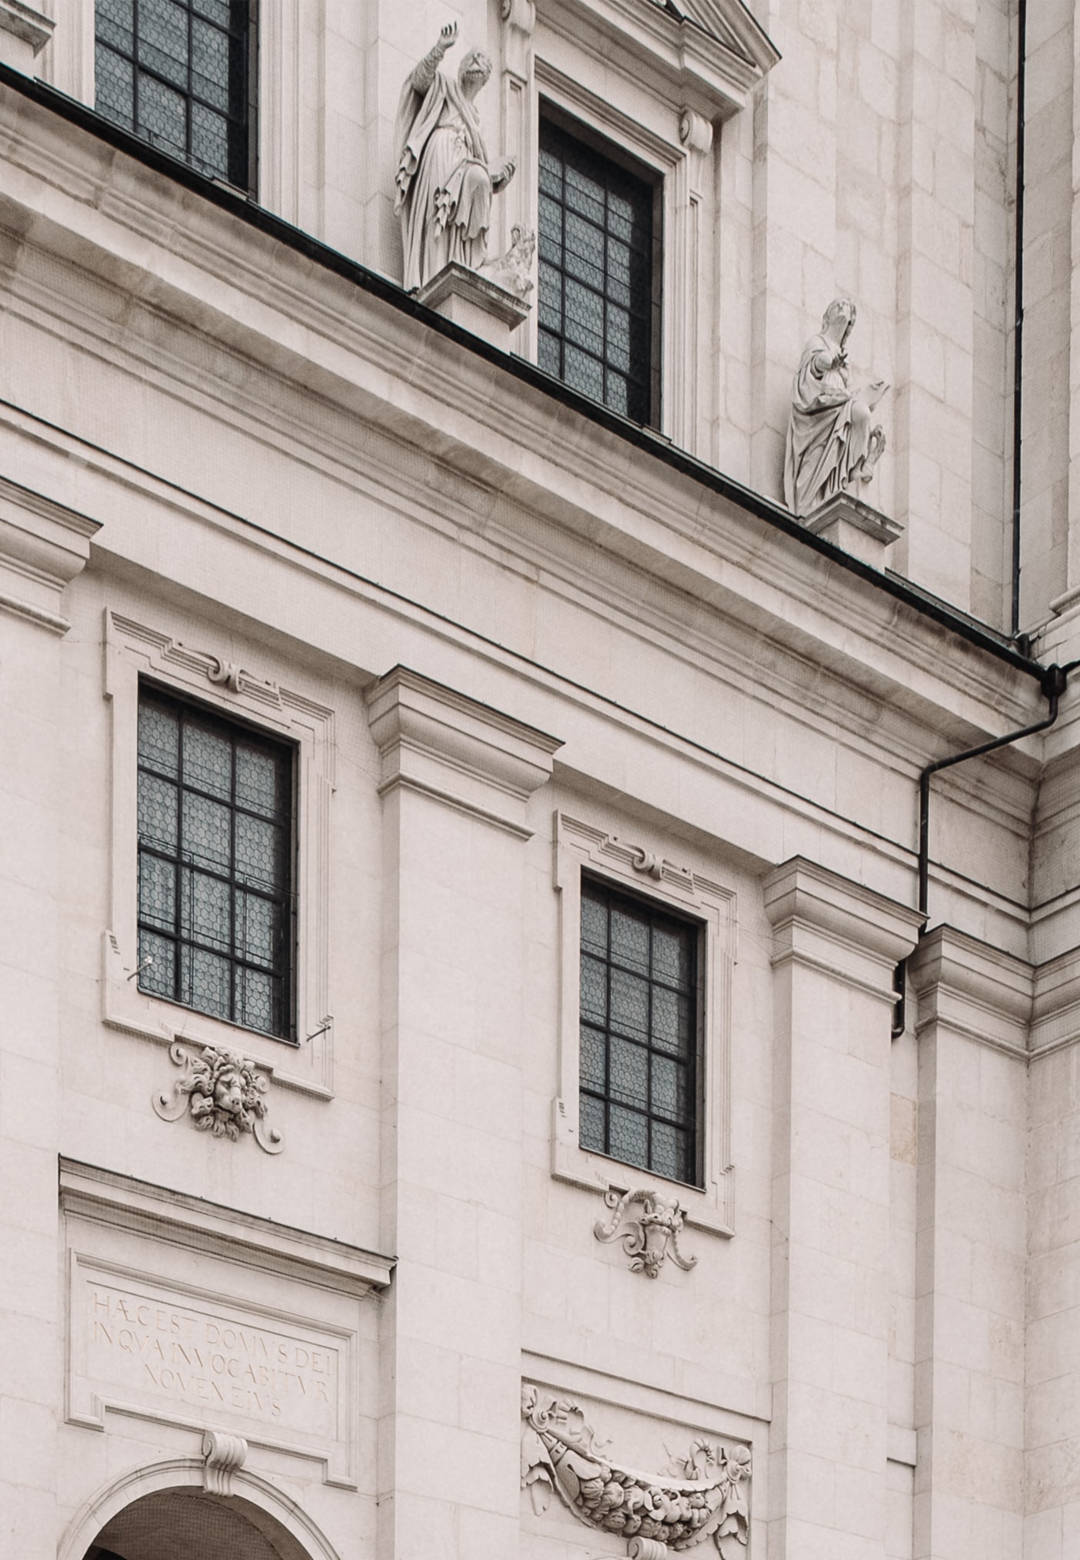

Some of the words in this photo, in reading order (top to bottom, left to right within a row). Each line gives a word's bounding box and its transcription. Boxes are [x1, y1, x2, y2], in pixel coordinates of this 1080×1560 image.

[92, 1320, 115, 1344] IN
[118, 1327, 165, 1360] QVA
[155, 1309, 198, 1339] EST
[295, 1347, 332, 1376] DEI
[143, 1362, 227, 1403] NOMEN
[231, 1386, 282, 1418] EIVS
